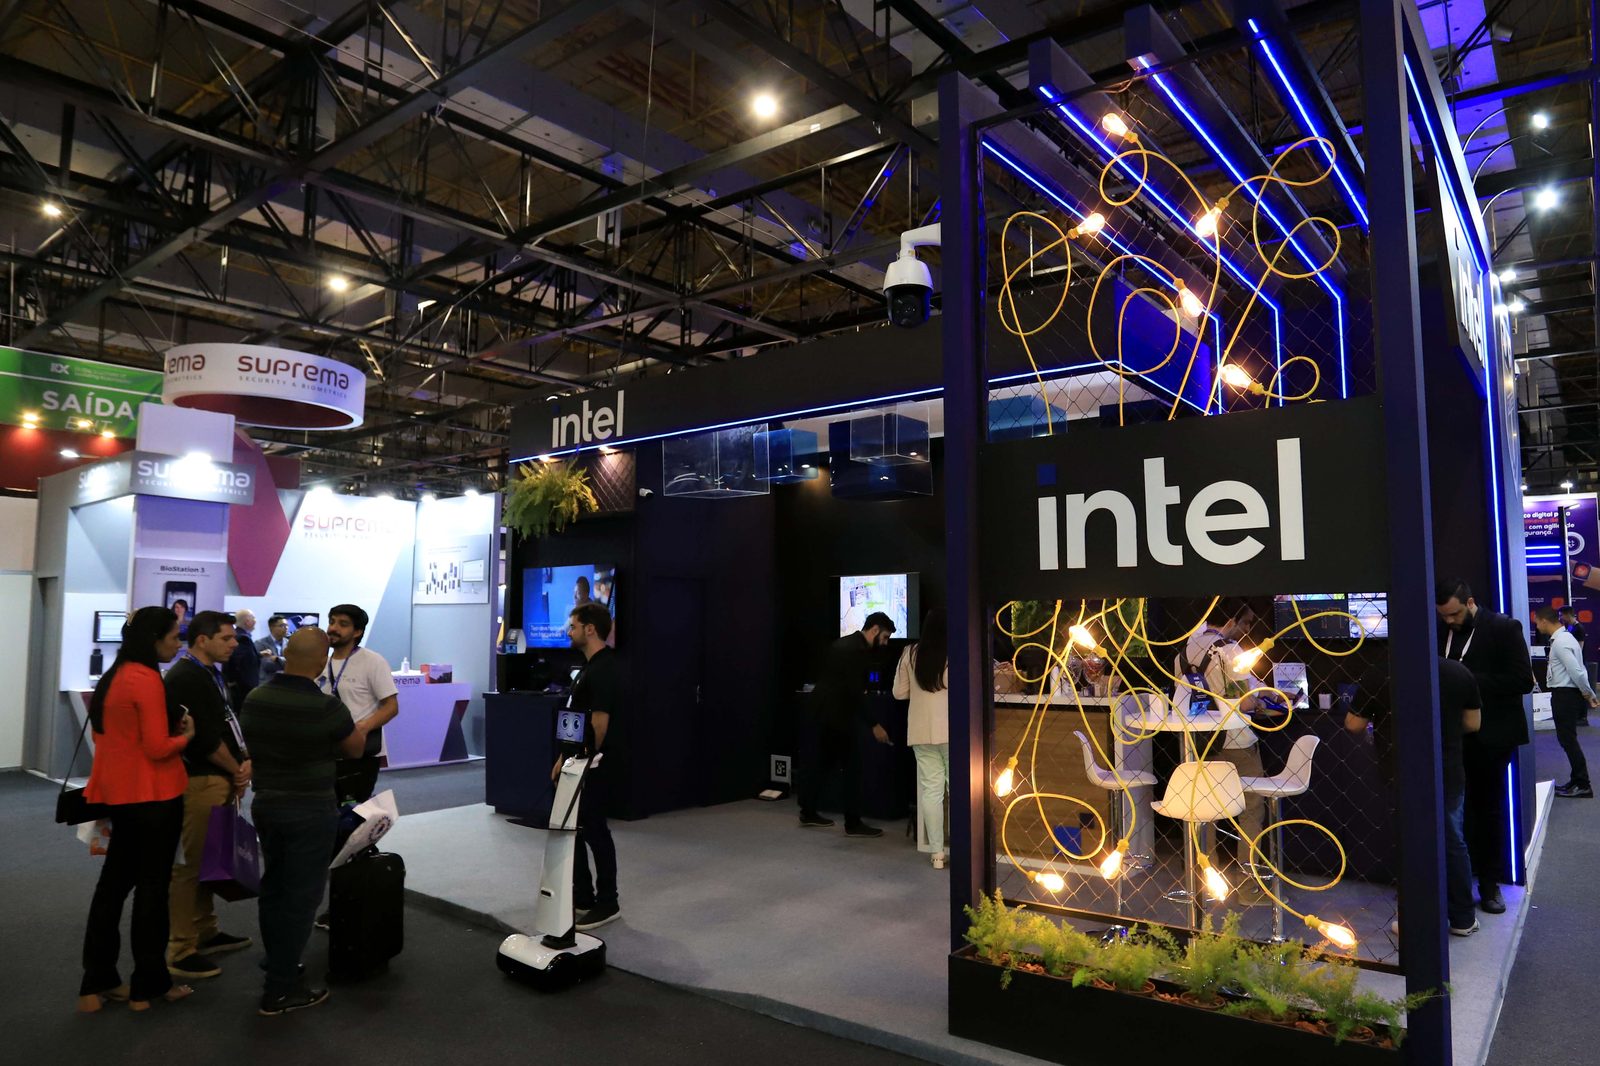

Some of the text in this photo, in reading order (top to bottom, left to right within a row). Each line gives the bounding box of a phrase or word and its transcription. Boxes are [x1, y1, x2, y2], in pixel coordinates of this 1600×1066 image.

[166, 354, 205, 374] ema
[237, 355, 349, 390] suprema
[42, 391, 134, 420] SAÍDA
[552, 390, 624, 448] intel
[137, 460, 250, 488] suma
[1037, 438, 1306, 570] intel
[160, 565, 199, 573] BioStation
